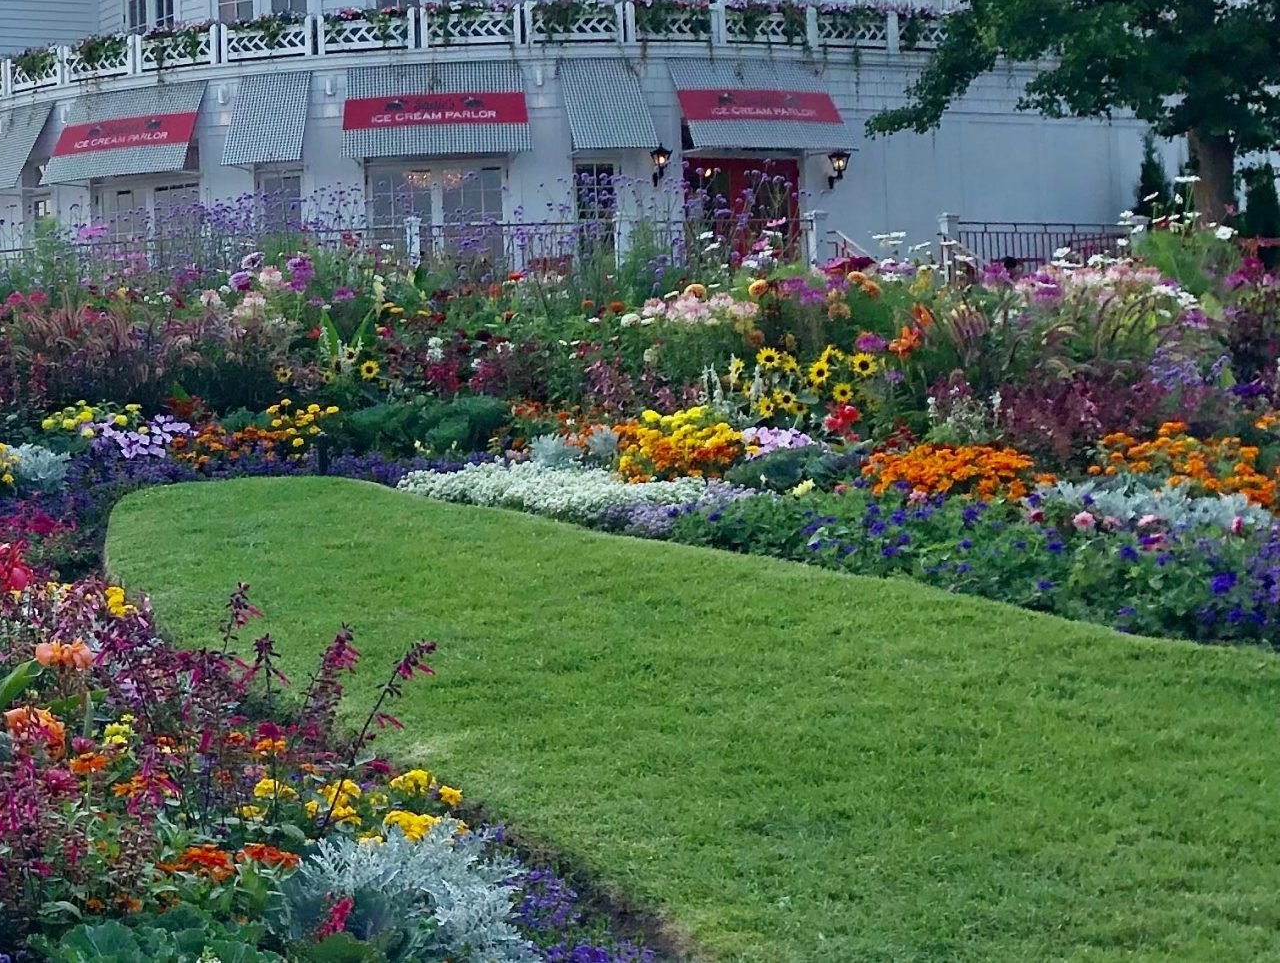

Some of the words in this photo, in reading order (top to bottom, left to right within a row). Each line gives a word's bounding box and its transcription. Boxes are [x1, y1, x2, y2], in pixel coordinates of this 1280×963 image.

[371, 113, 392, 123] ICE
[395, 111, 442, 122] CREAM
[445, 109, 497, 120] PARLOR
[74, 140, 89, 149] ICE
[91, 136, 125, 147] CREAM
[128, 131, 169, 143] PARLOR
